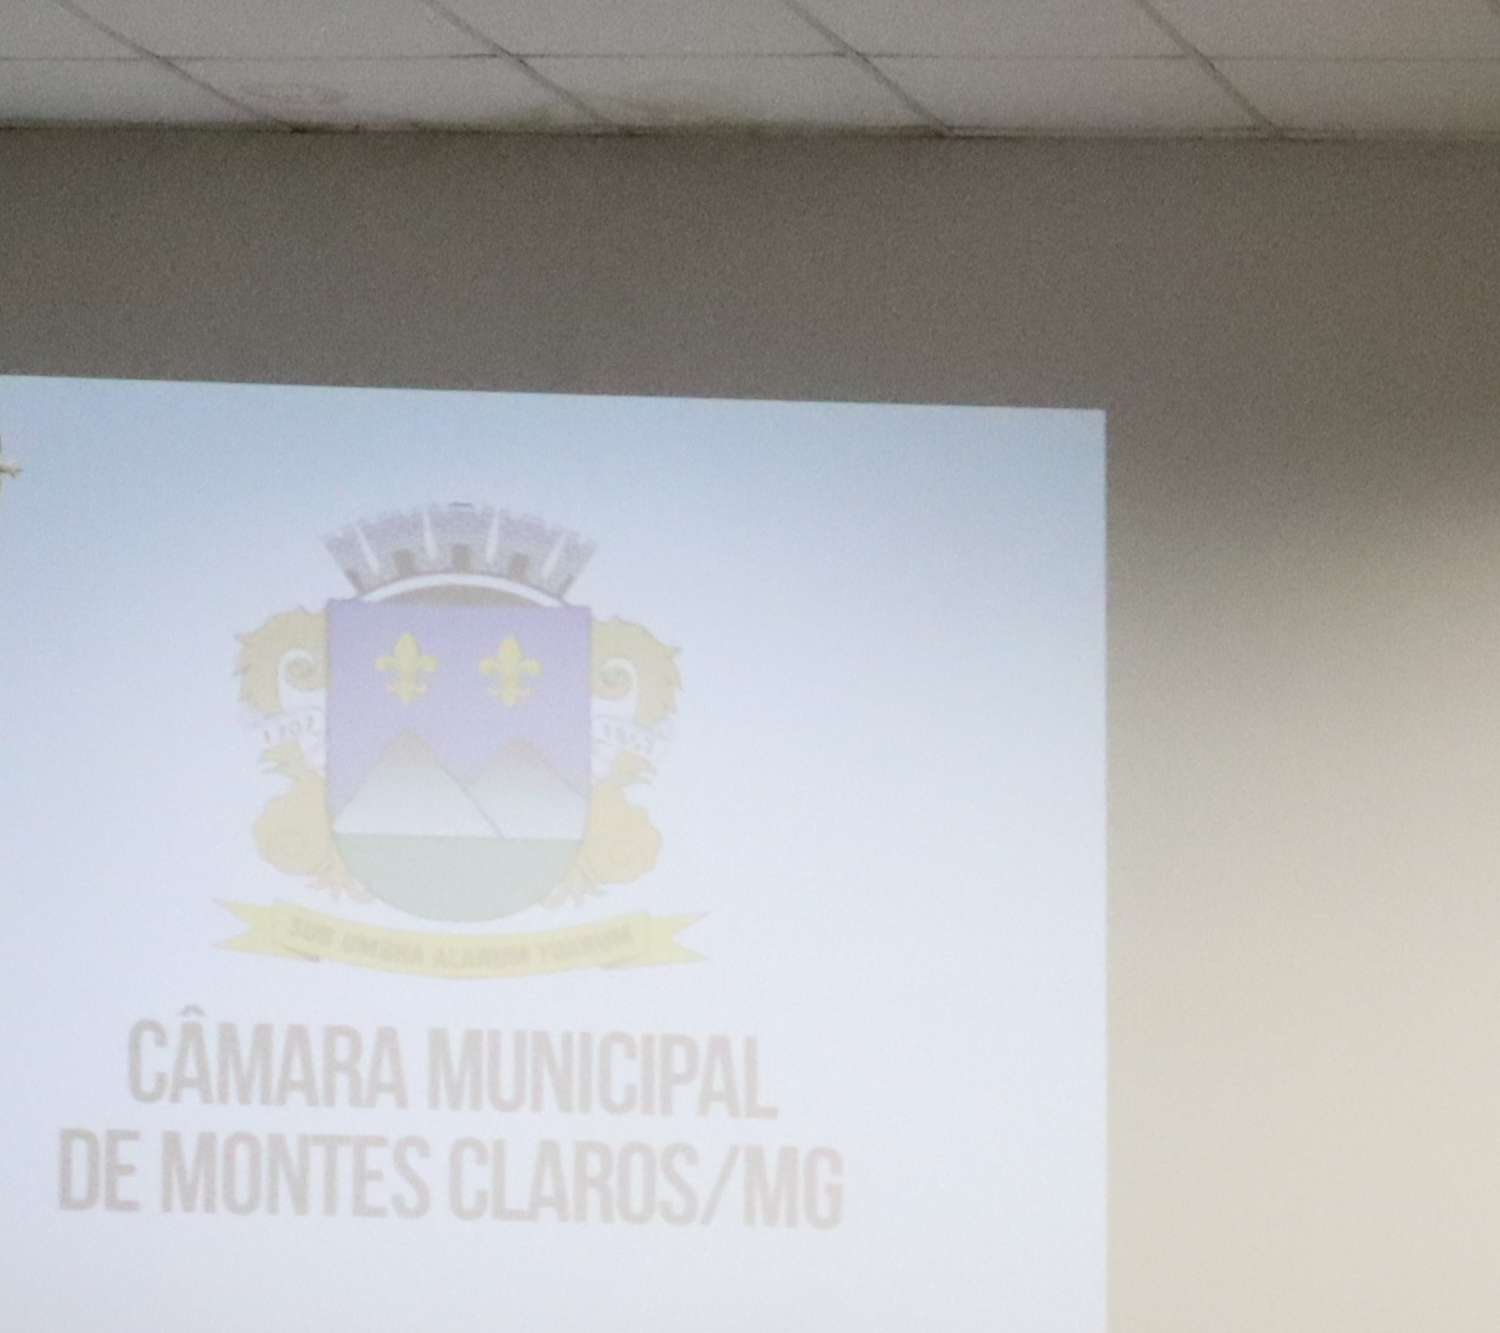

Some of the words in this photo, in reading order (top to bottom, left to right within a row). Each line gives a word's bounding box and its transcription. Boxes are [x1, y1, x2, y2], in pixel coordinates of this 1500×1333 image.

[126, 1004, 409, 1110] CÂMARA
[426, 1026, 780, 1120] MUNICIPAL
[57, 1127, 141, 1213] DE
[160, 1129, 432, 1221] MONTES
[447, 1135, 846, 1231] CLAROS/MG
